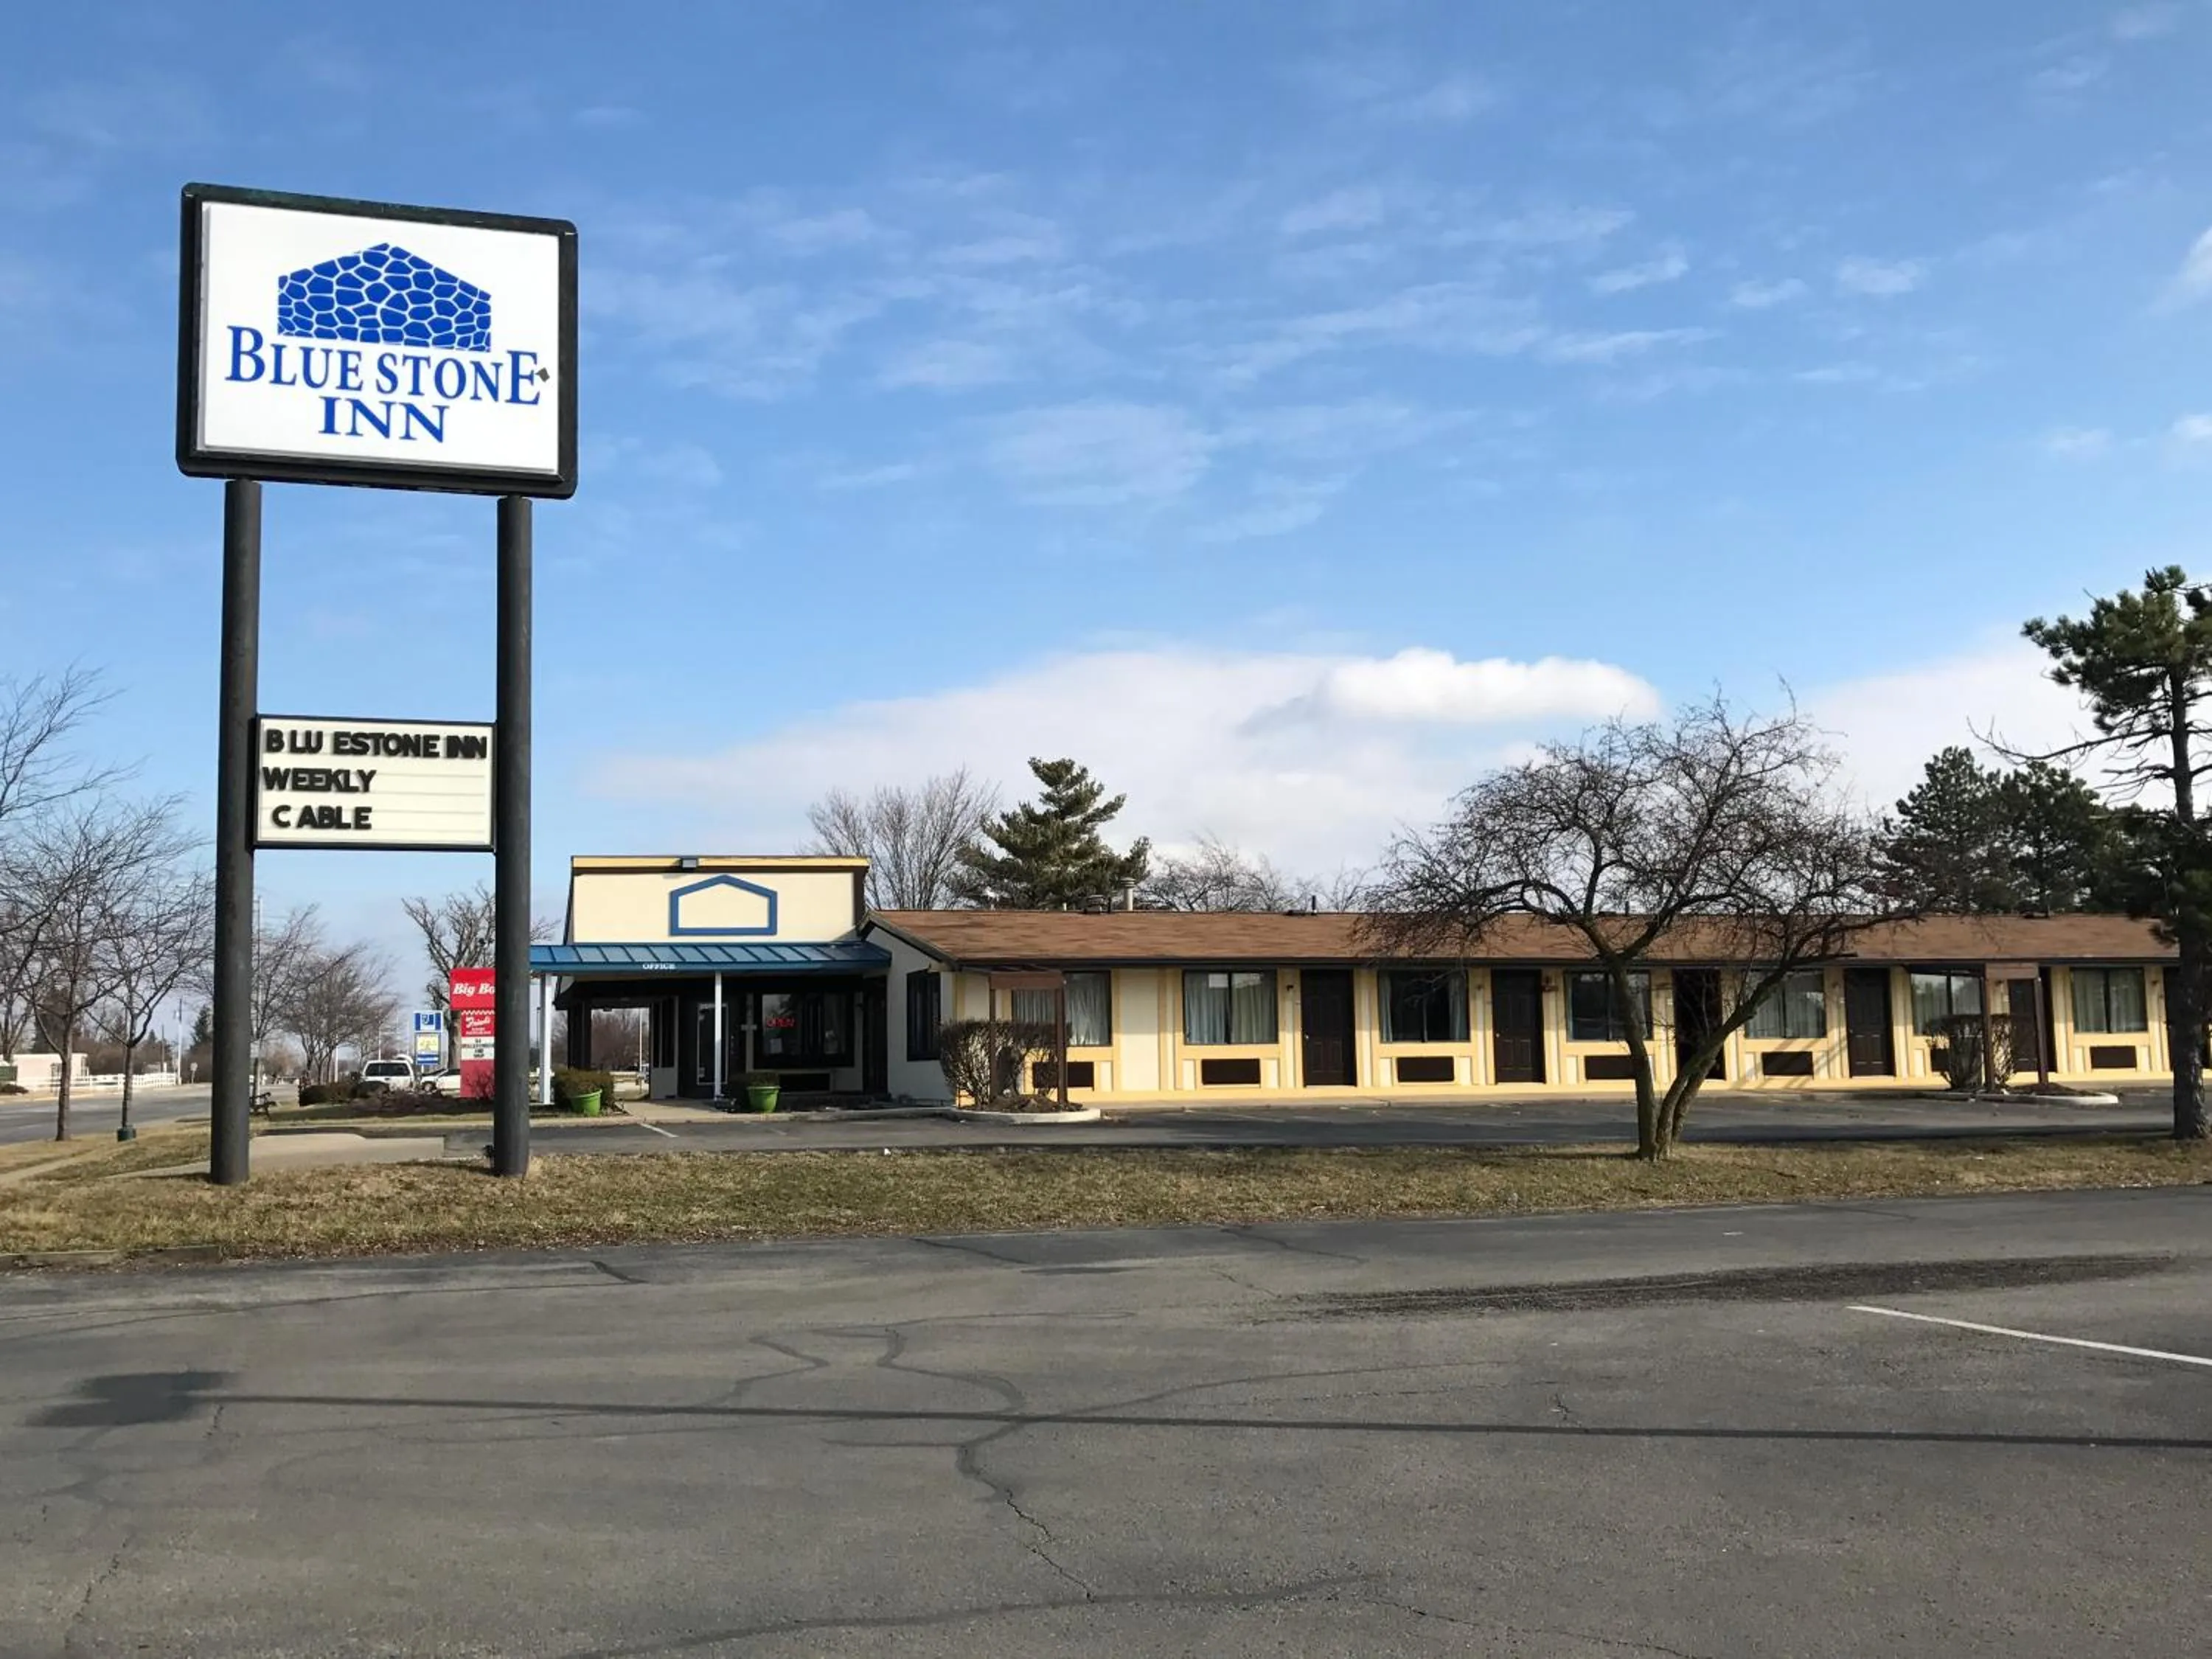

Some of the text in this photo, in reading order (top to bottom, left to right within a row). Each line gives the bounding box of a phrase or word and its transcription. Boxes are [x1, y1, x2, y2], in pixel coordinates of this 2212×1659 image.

[318, 395, 450, 444] INN
[445, 735, 487, 759] INN
[262, 766, 378, 793] WEEKLY
[453, 982, 496, 998] Big Bo
